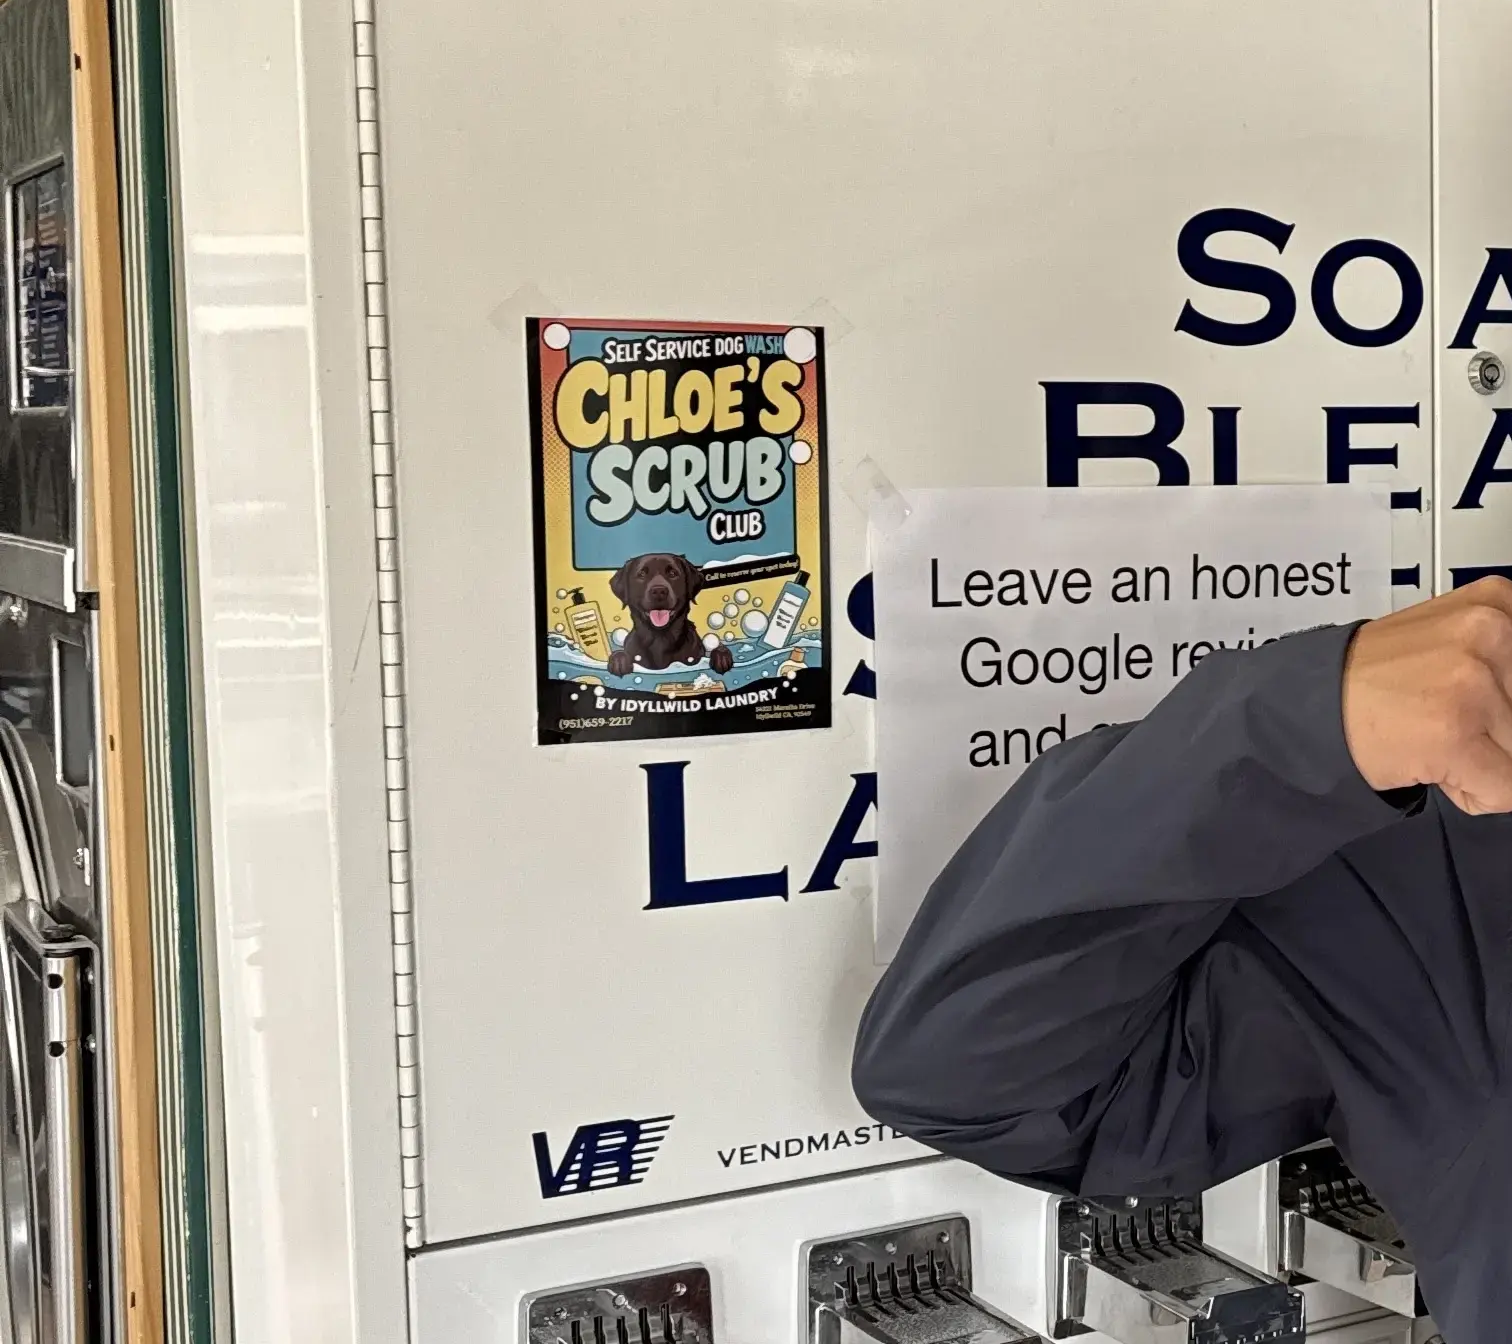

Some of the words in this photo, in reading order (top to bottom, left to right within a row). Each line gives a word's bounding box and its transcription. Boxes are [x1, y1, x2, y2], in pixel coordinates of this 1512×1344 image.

[604, 338, 643, 365] SELF
[644, 336, 712, 362] SERVICE
[714, 334, 744, 357] DOG
[744, 334, 784, 356] WASH
[556, 356, 804, 449] CHLOE'S
[588, 436, 785, 525] SCRUB
[709, 511, 764, 542] CLUB
[930, 556, 1092, 610] Leave
[1111, 565, 1174, 603] an
[1192, 550, 1352, 599] honest
[961, 633, 1156, 698] Google
[595, 696, 618, 711] BY
[620, 695, 702, 714] IDYLLWILD
[705, 687, 779, 712] LAUNDRY
[968, 712, 1067, 768] and
[716, 1122, 906, 1168] VENDMAST
